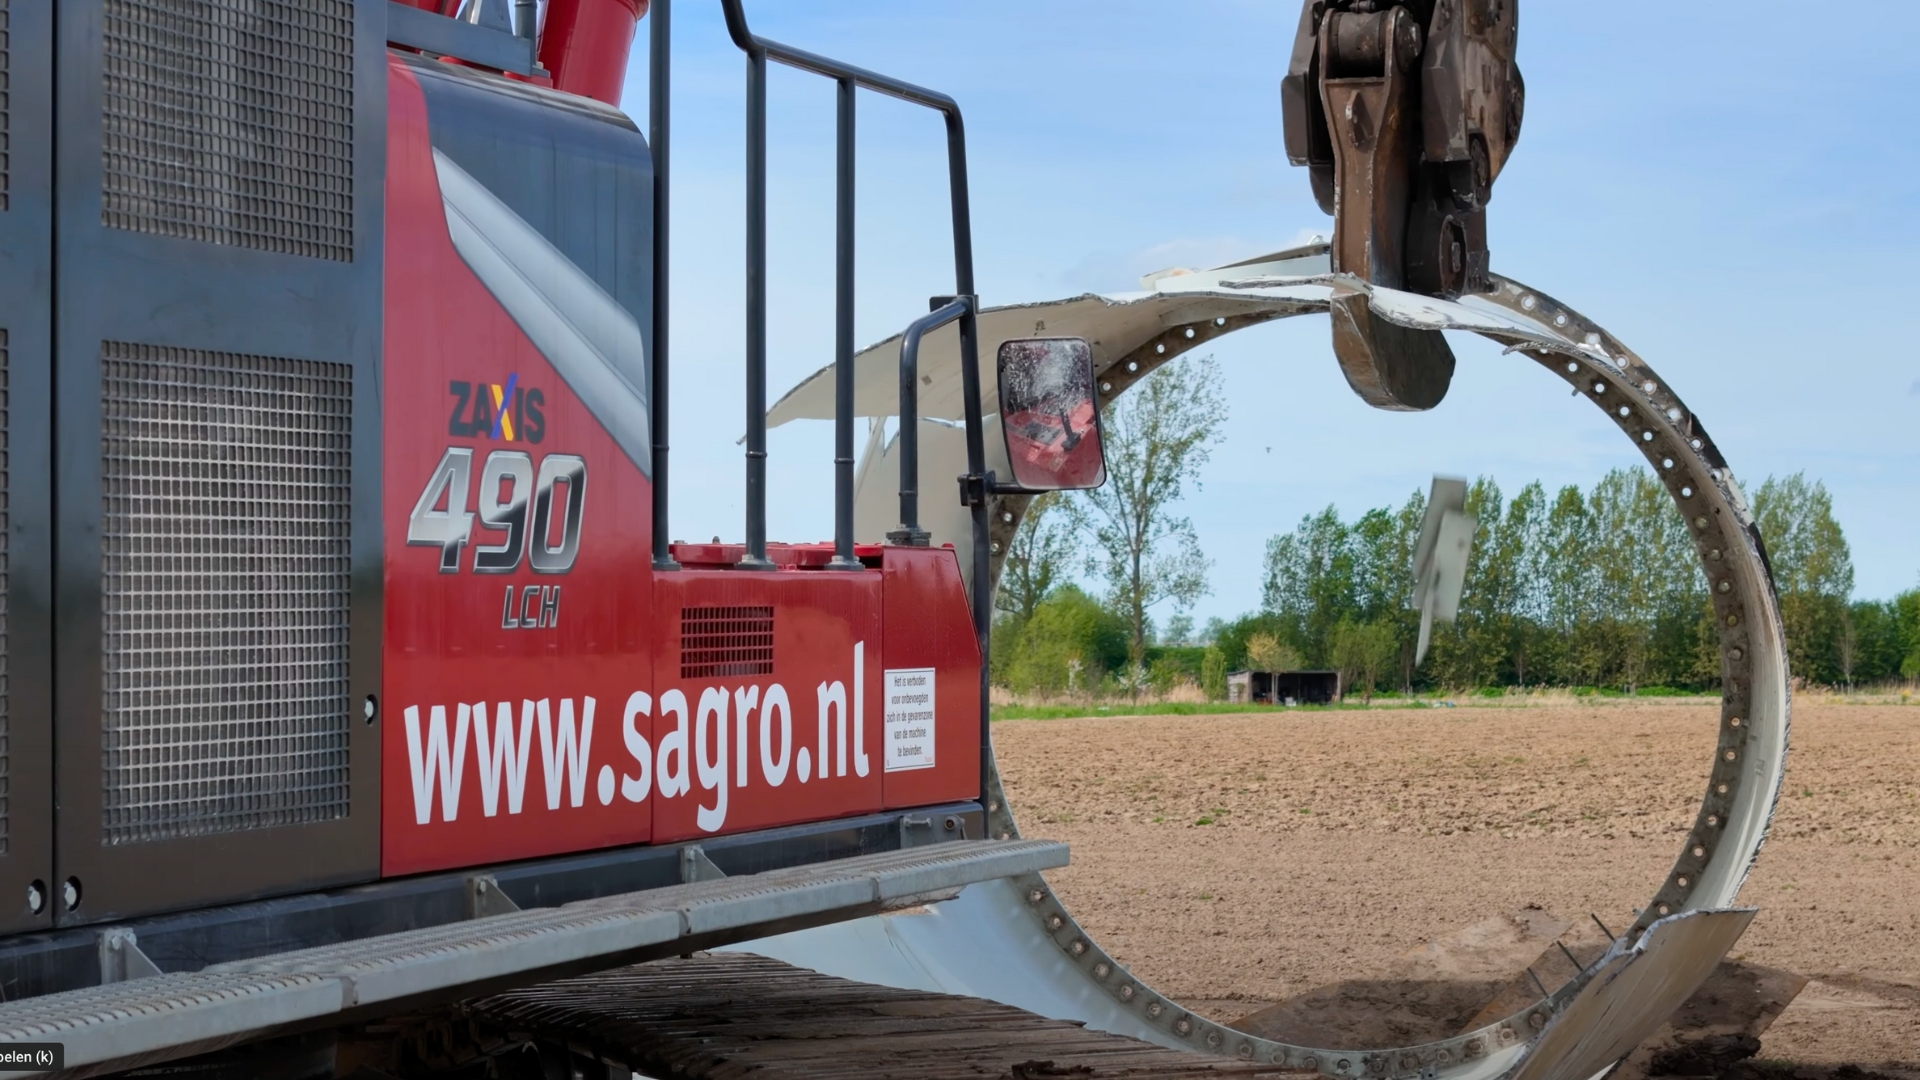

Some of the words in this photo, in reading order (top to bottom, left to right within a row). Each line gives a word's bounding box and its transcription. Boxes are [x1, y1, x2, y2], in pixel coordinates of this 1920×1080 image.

[449, 373, 545, 444] ZAXIS
[406, 447, 587, 574] 490
[501, 585, 560, 629] LCH
[902, 676, 906, 687] is
[907, 675, 926, 686] verboden
[891, 695, 901, 705] voor
[901, 692, 928, 706] onbevoegden
[887, 711, 895, 723] zich
[902, 711, 906, 721] de
[908, 711, 933, 724] gevarenzone
[404, 641, 869, 832] www.sagro.nl
[903, 728, 907, 739] de
[909, 727, 926, 738] machine
[898, 746, 902, 757] te
